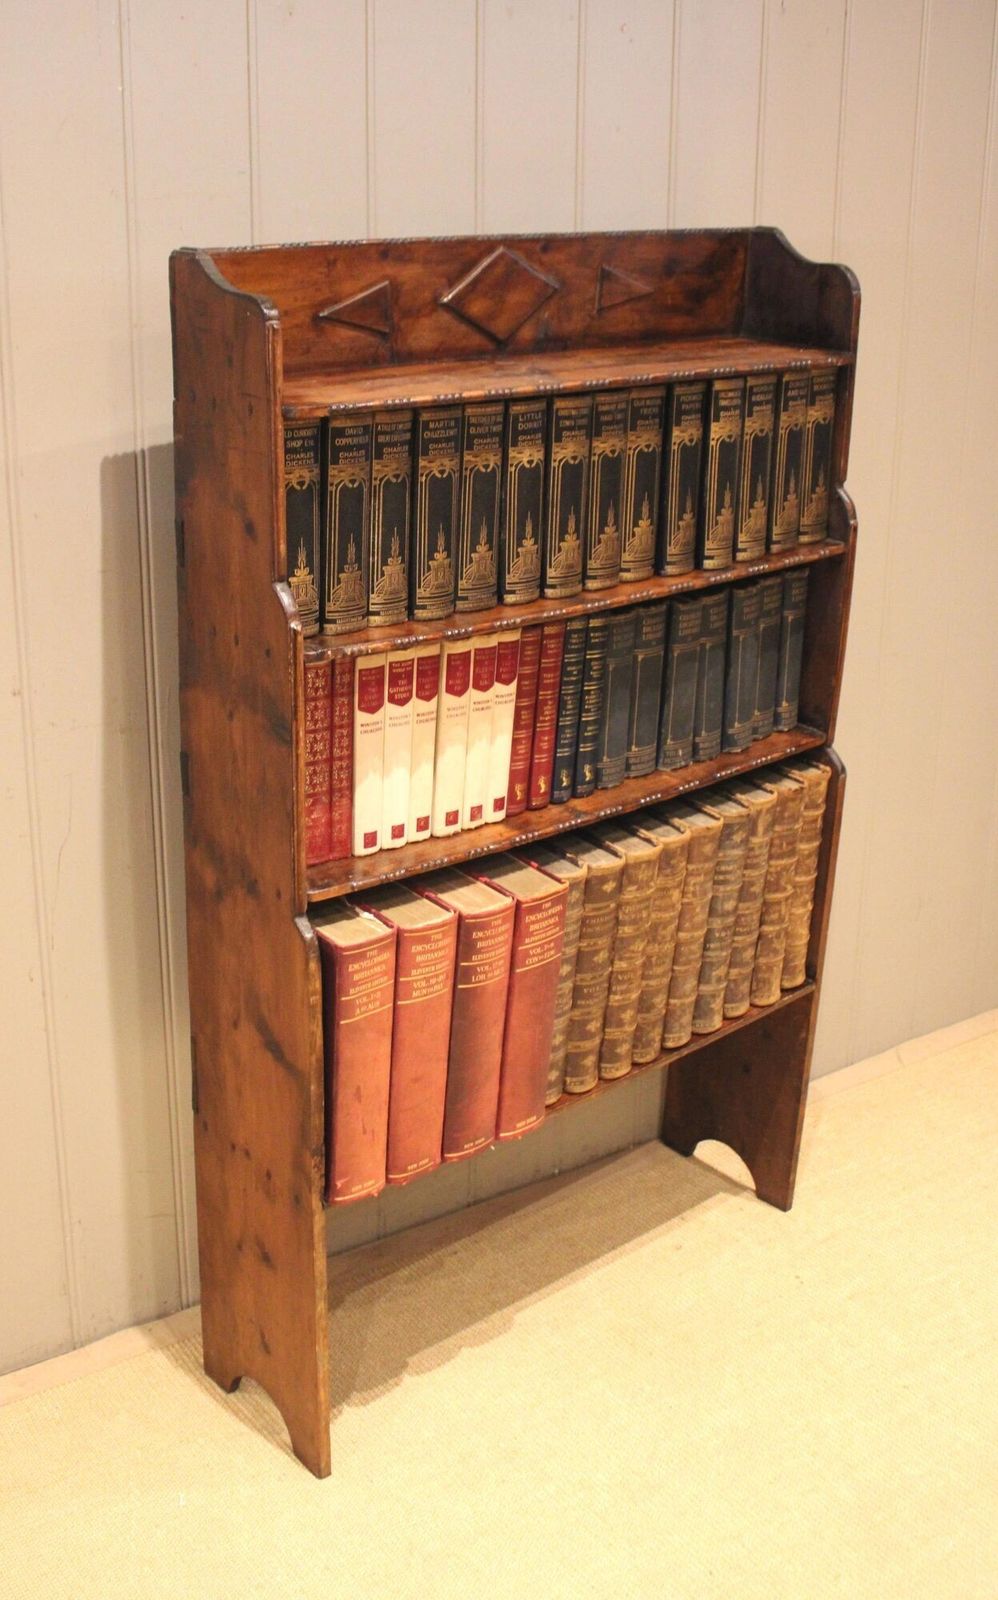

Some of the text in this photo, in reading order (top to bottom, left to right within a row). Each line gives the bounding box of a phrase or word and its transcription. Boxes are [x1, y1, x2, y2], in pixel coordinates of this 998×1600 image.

[520, 412, 541, 421] LITTLE
[429, 420, 454, 429] MARTIN
[518, 422, 541, 430] DORRIT
[345, 427, 364, 436] DAVID
[286, 439, 303, 448] SHOP
[335, 436, 369, 446] COPPERFIELD
[339, 450, 365, 458] CHARLES
[384, 445, 408, 454] CHARLES
[429, 448, 454, 456] DICKENS
[286, 452, 314, 460] CHARLES
[384, 452, 408, 460] DICKENS
[286, 459, 314, 468] DICKENS
[339, 457, 365, 465] DICKENS
[542, 902, 551, 910] THE
[529, 916, 559, 932] BRITANNICA
[431, 933, 442, 941] THE
[477, 934, 507, 948] BRITANNICA
[366, 950, 377, 958] THE
[416, 948, 448, 962] BRITANNICA
[353, 963, 386, 981] BRITANNICA
